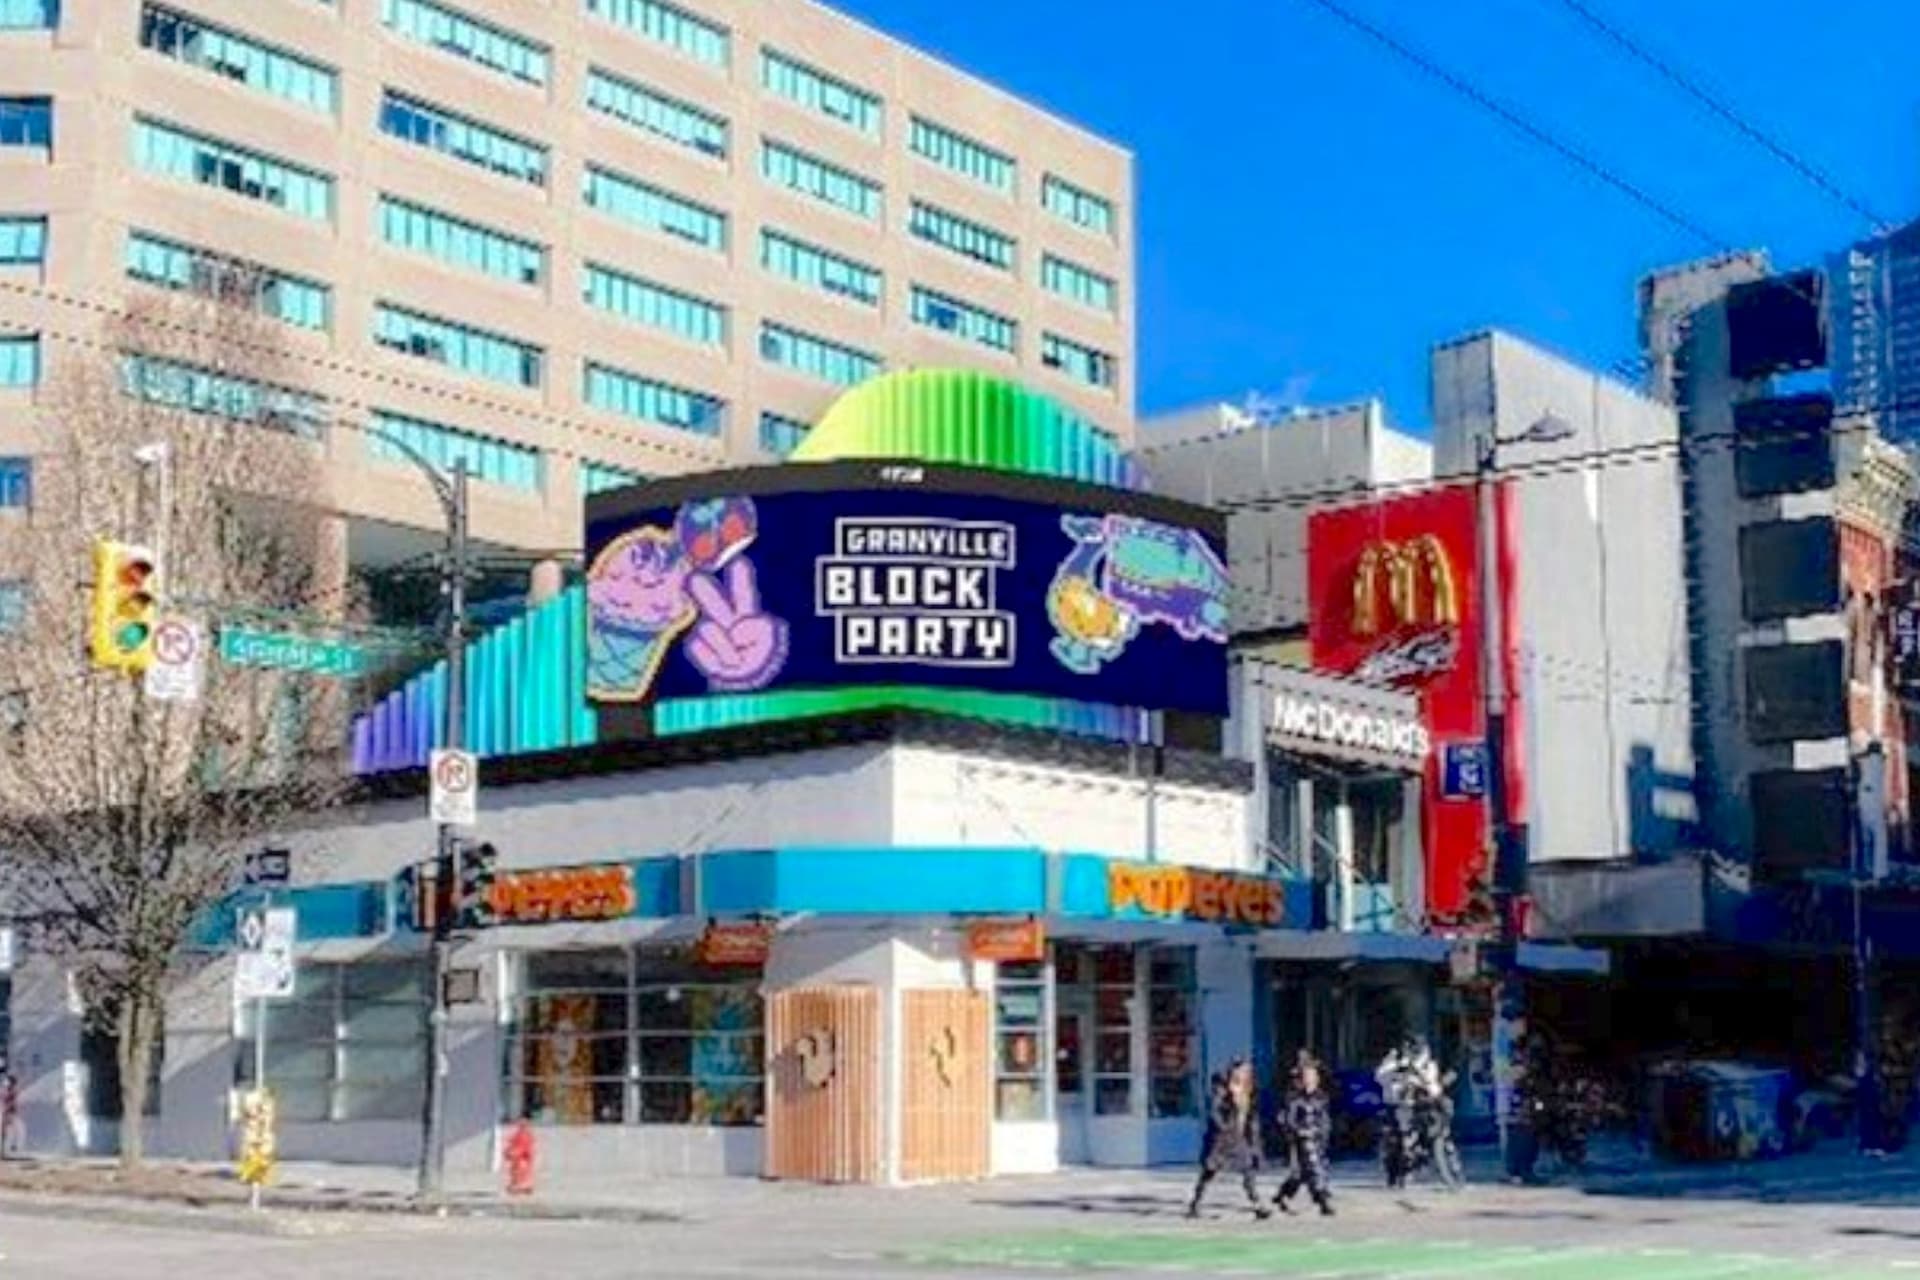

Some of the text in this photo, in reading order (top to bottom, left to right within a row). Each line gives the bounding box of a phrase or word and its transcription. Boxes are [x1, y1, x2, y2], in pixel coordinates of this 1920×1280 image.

[847, 527, 1006, 558] GRANVILLE
[826, 565, 983, 607] BLOCK
[847, 616, 1003, 658] PARTY
